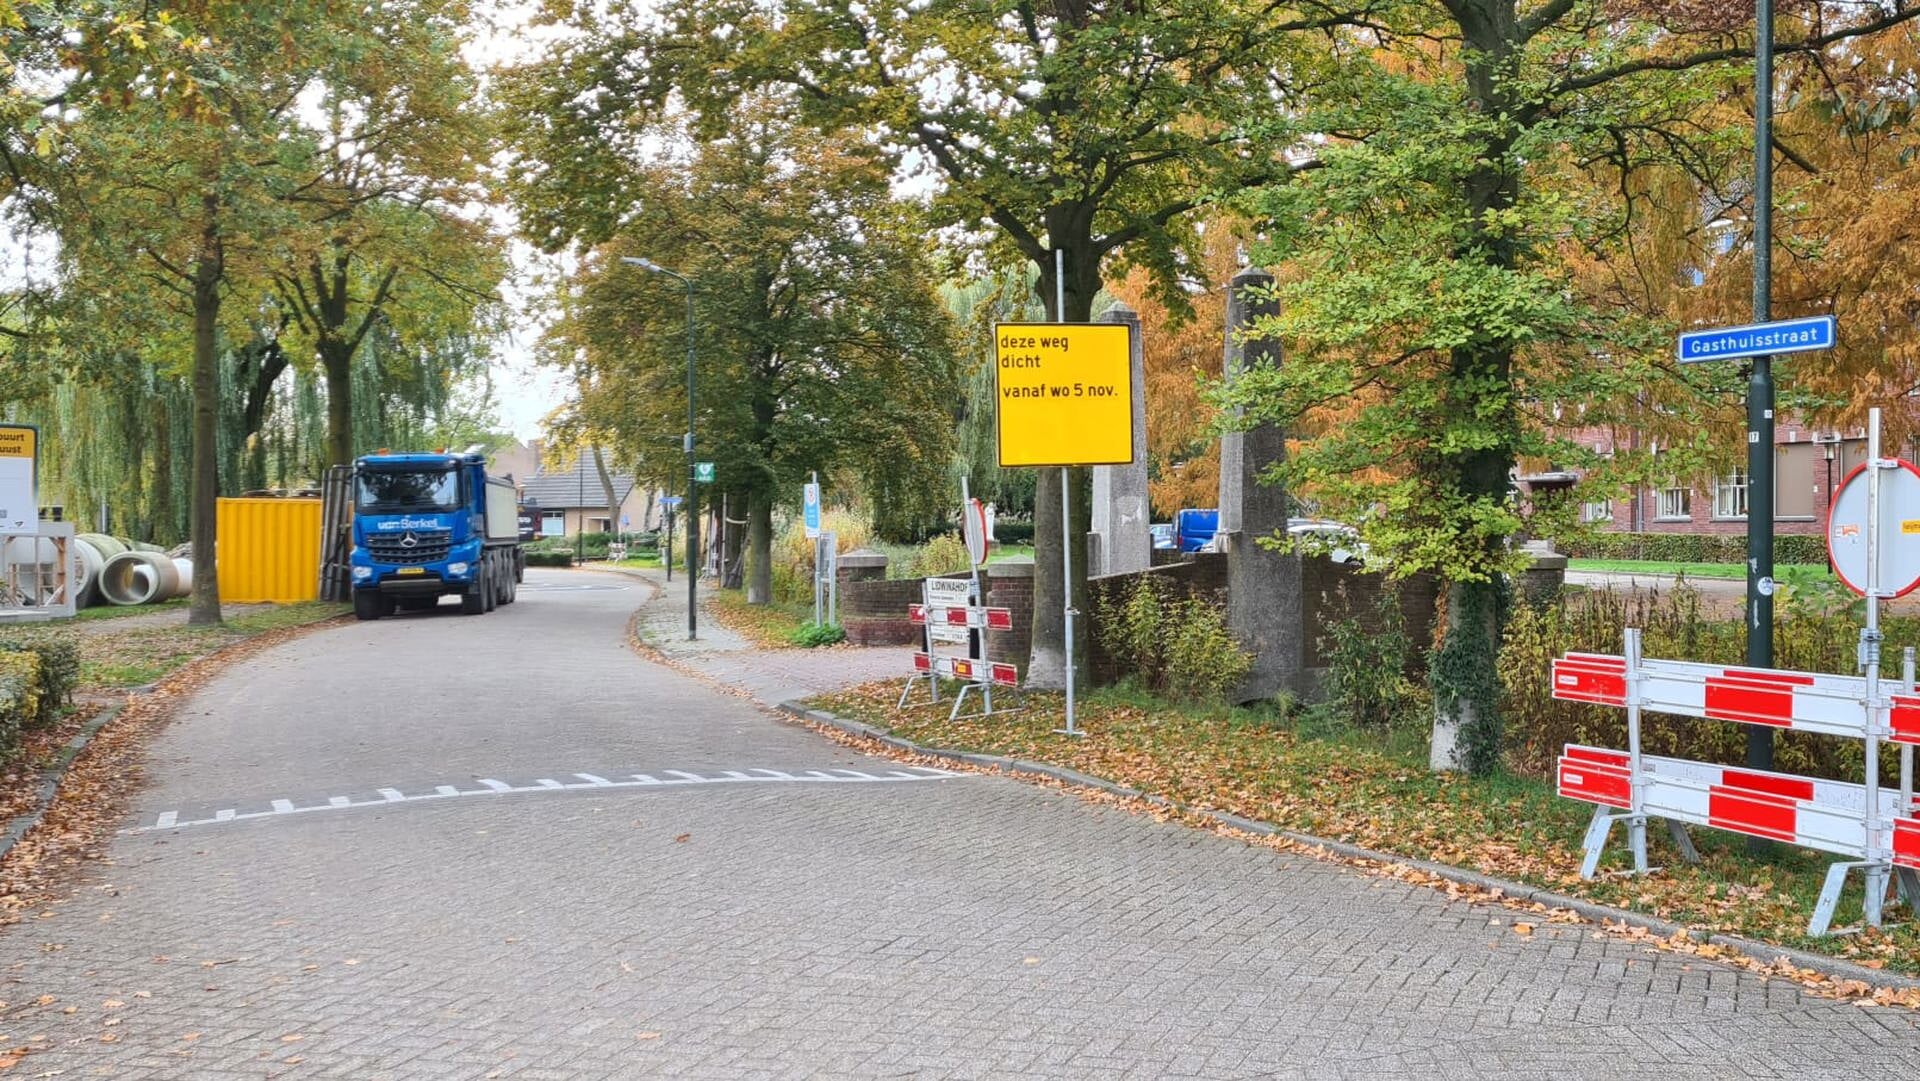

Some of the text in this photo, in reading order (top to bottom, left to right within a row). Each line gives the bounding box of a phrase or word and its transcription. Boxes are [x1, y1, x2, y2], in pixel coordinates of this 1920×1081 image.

[1000, 335, 1069, 352] deze weg
[1691, 327, 1818, 354] Gasthuisstraat
[1001, 354, 1041, 368] dicht
[1003, 383, 1118, 398] vanaf wo 5 nov.
